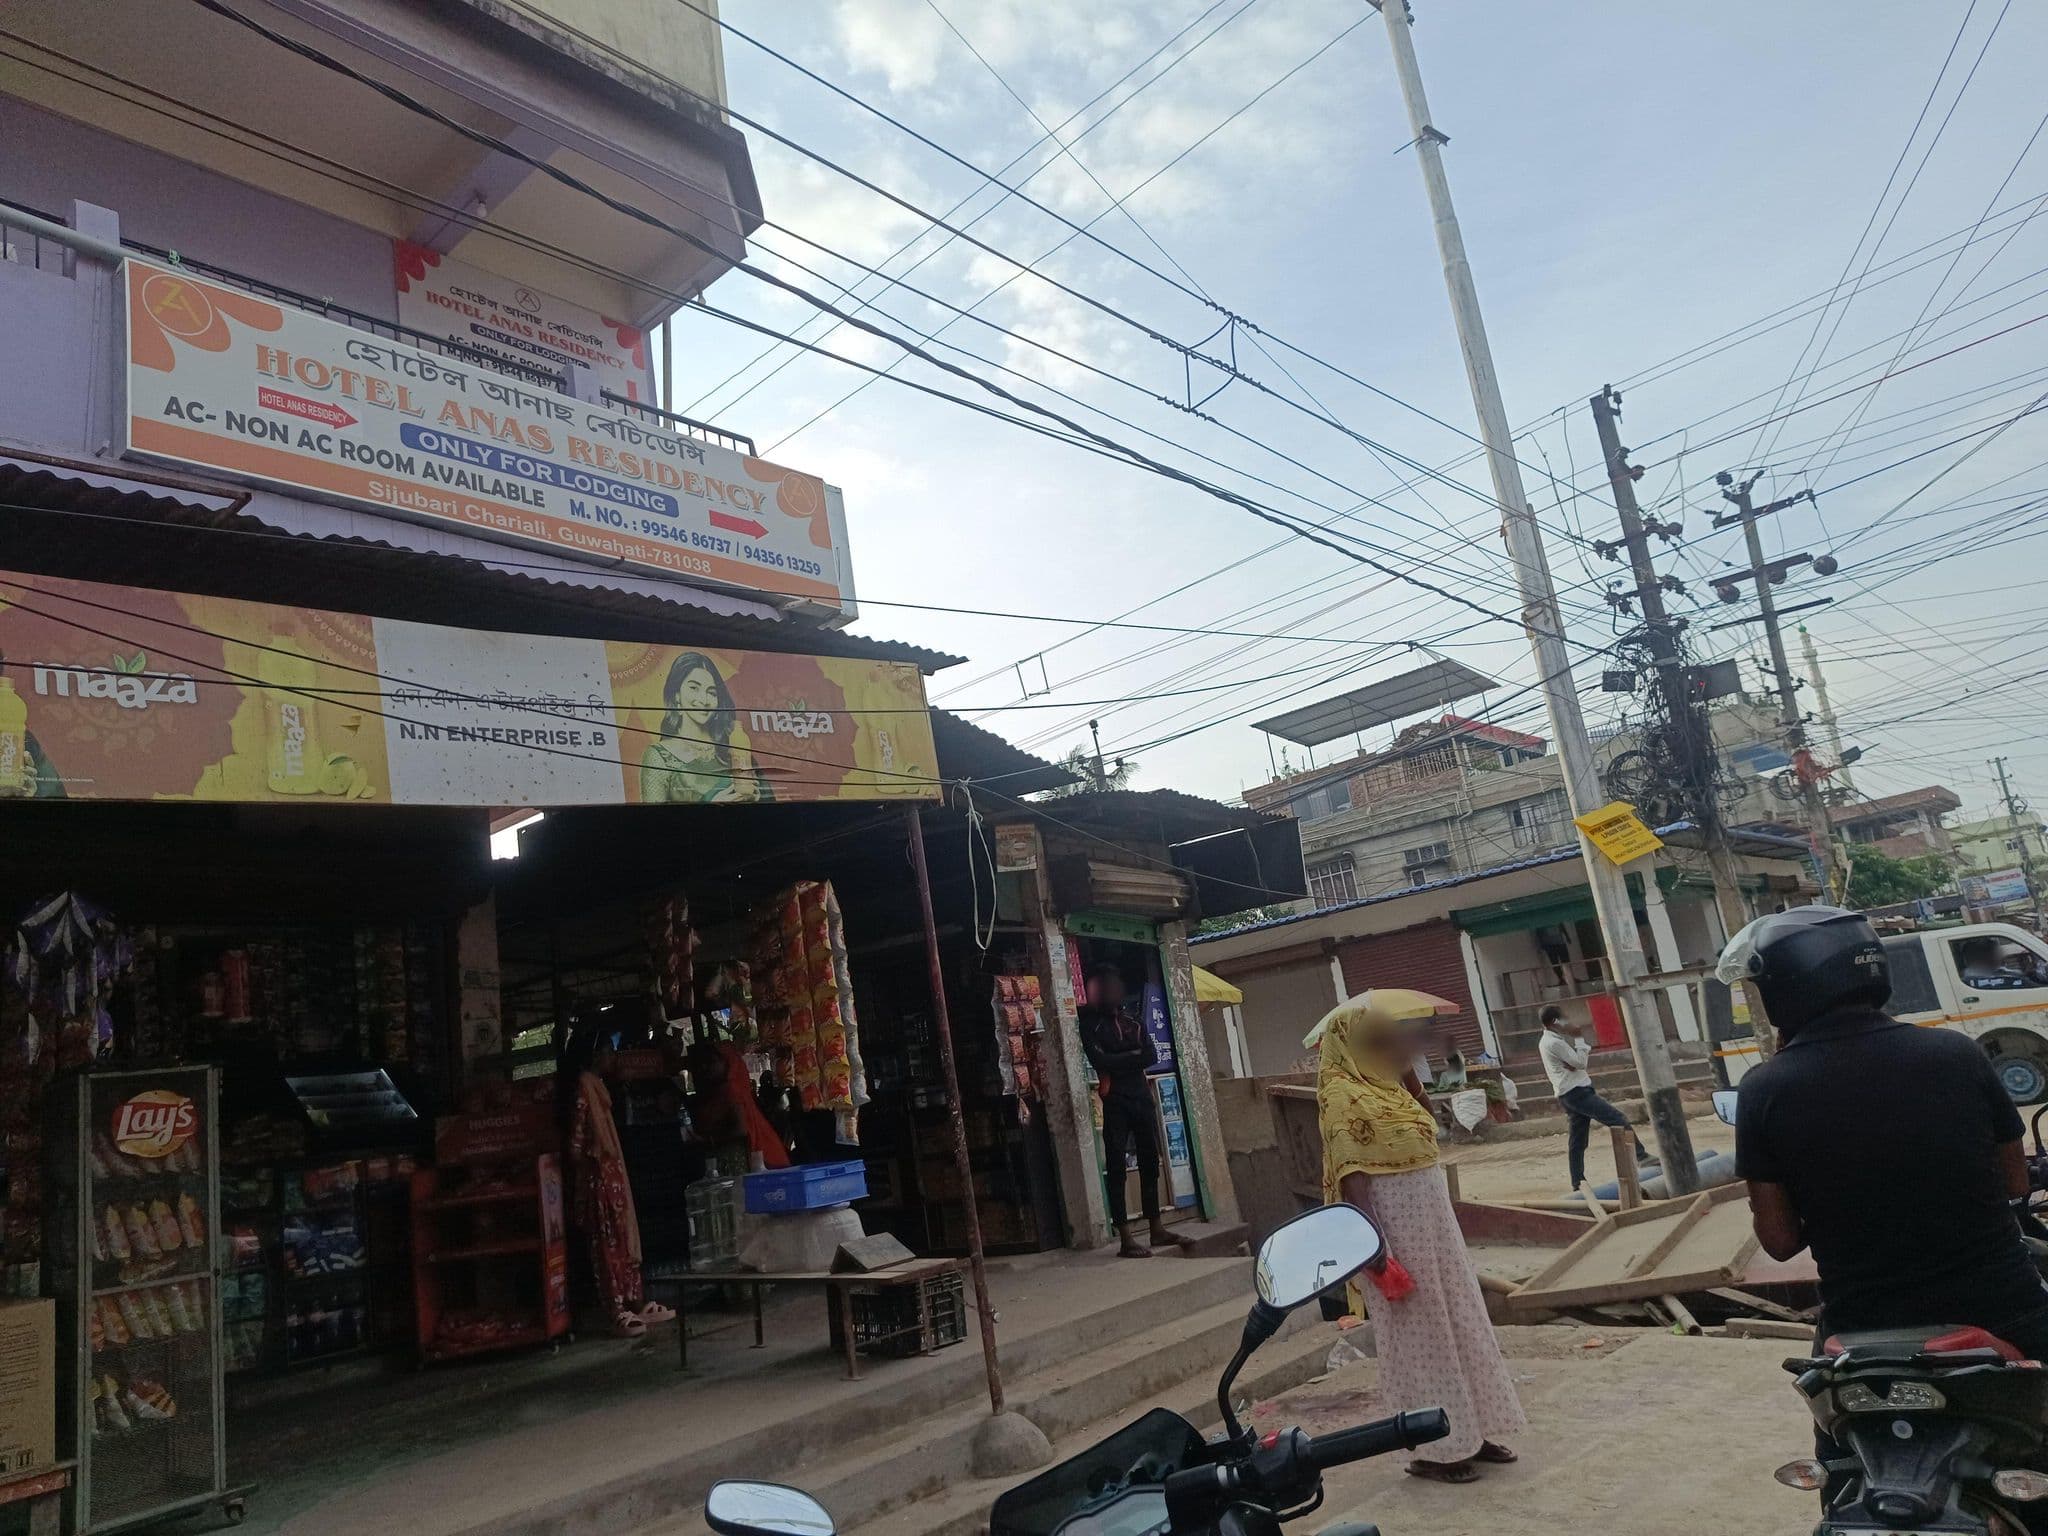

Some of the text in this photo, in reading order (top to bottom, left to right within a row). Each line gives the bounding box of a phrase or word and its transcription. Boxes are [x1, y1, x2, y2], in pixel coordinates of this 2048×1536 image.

[426, 290, 625, 369] HOTEL ANAS RESIDENCY
[477, 326, 508, 344] ONLY
[510, 337, 534, 353] FOR
[261, 390, 348, 424] HOTEL ANAS RESIDENCY
[345, 339, 468, 393] হোটেল
[477, 378, 576, 427] আনাছ
[164, 396, 545, 509] AC- NON AC ROOM AVAILABLE
[256, 344, 766, 514] HOTEL ANAS RESIDENCY
[418, 431, 666, 512] ONLY FOR LODGING
[368, 479, 458, 516] Sijubari
[558, 526, 712, 575] Guwahati-781038
[640, 519, 688, 544] 99546
[690, 531, 731, 555] 86737
[743, 545, 784, 568] 94356
[785, 554, 822, 577] 13259
[33, 660, 198, 710] maaza
[279, 702, 305, 776] maaza
[446, 725, 582, 747] ENTERPRISE
[750, 710, 834, 738] maaza
[116, 1097, 194, 1146] Lay's
